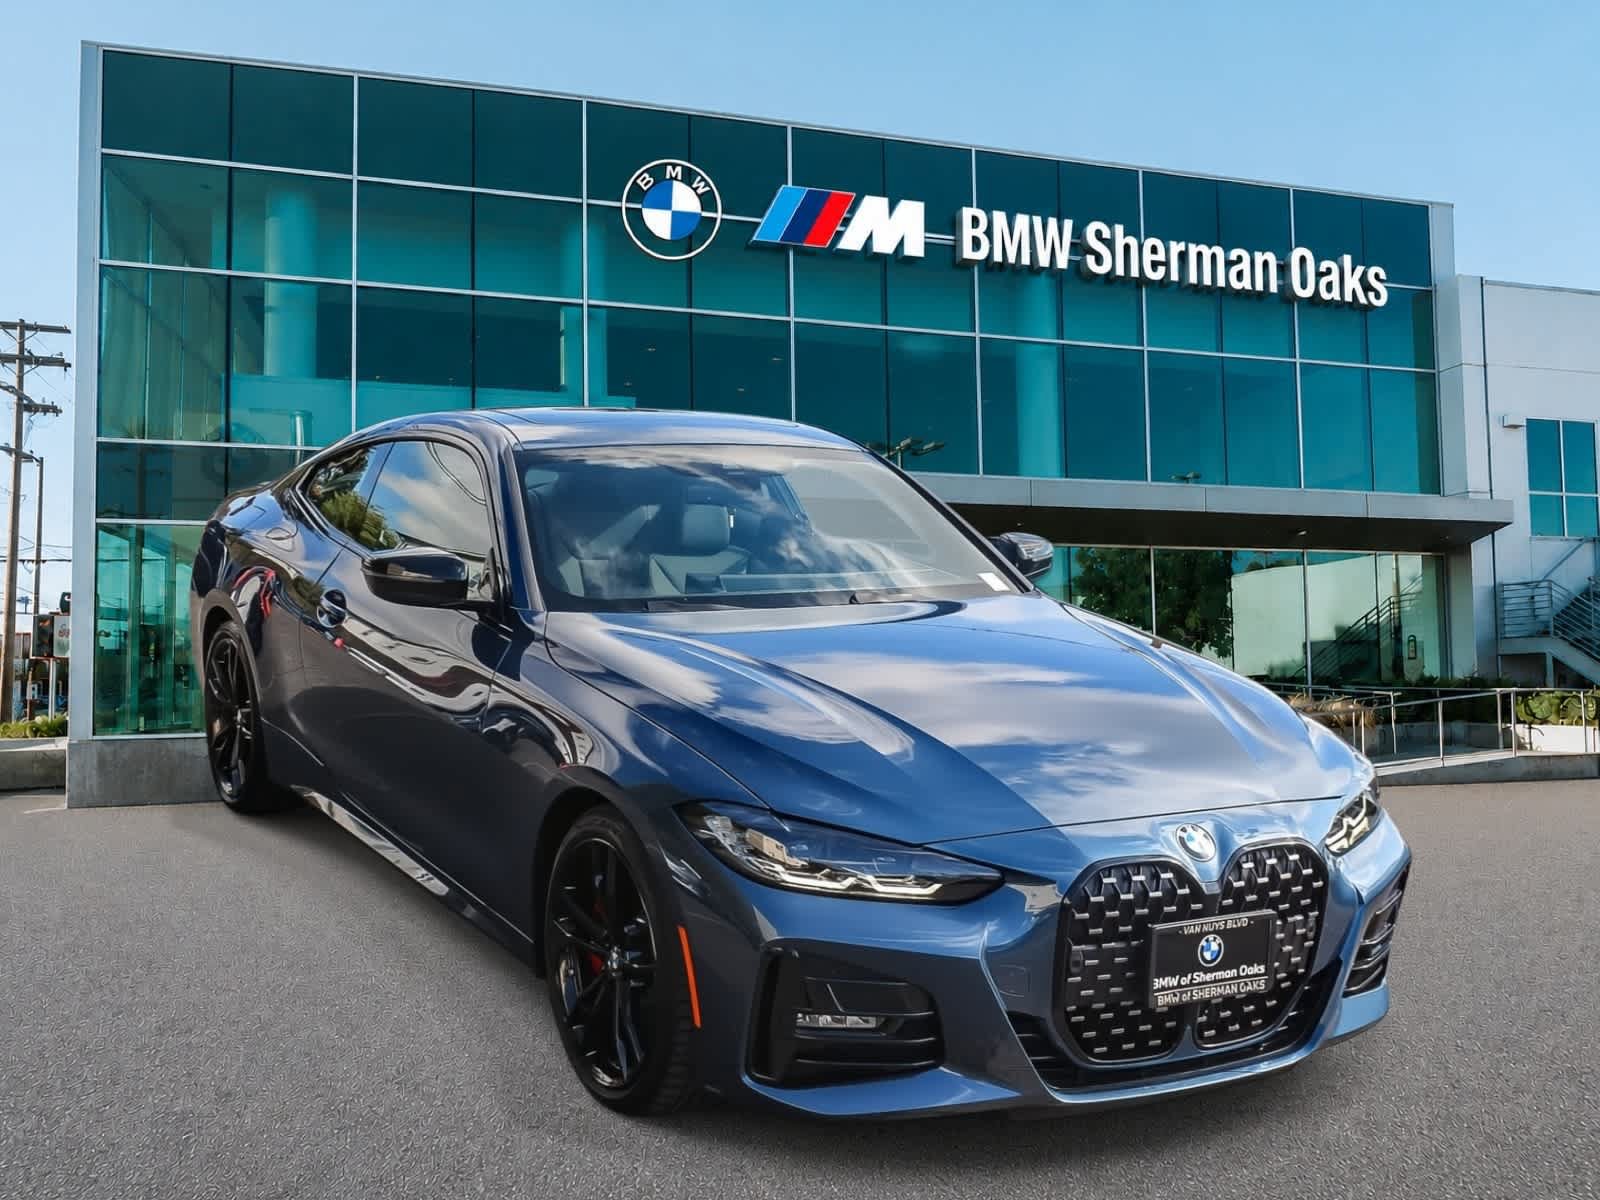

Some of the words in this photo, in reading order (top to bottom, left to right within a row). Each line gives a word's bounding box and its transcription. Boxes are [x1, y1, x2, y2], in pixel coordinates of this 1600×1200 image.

[636, 164, 711, 195] BMW
[960, 206, 1073, 270] BMW
[1084, 220, 1279, 294] Sherman
[1289, 246, 1389, 308] Oaks
[1183, 924, 1201, 935] VAN
[1202, 920, 1226, 933] NUYS
[1226, 917, 1249, 929] BLVD
[1180, 973, 1192, 986] of
[1192, 968, 1238, 983] Sherman
[1239, 963, 1266, 977] Oaks
[1157, 992, 1180, 1006] BMW
[1182, 990, 1191, 1002] of
[1192, 983, 1238, 1000] SHERMAN
[1239, 979, 1266, 993] OAKS
